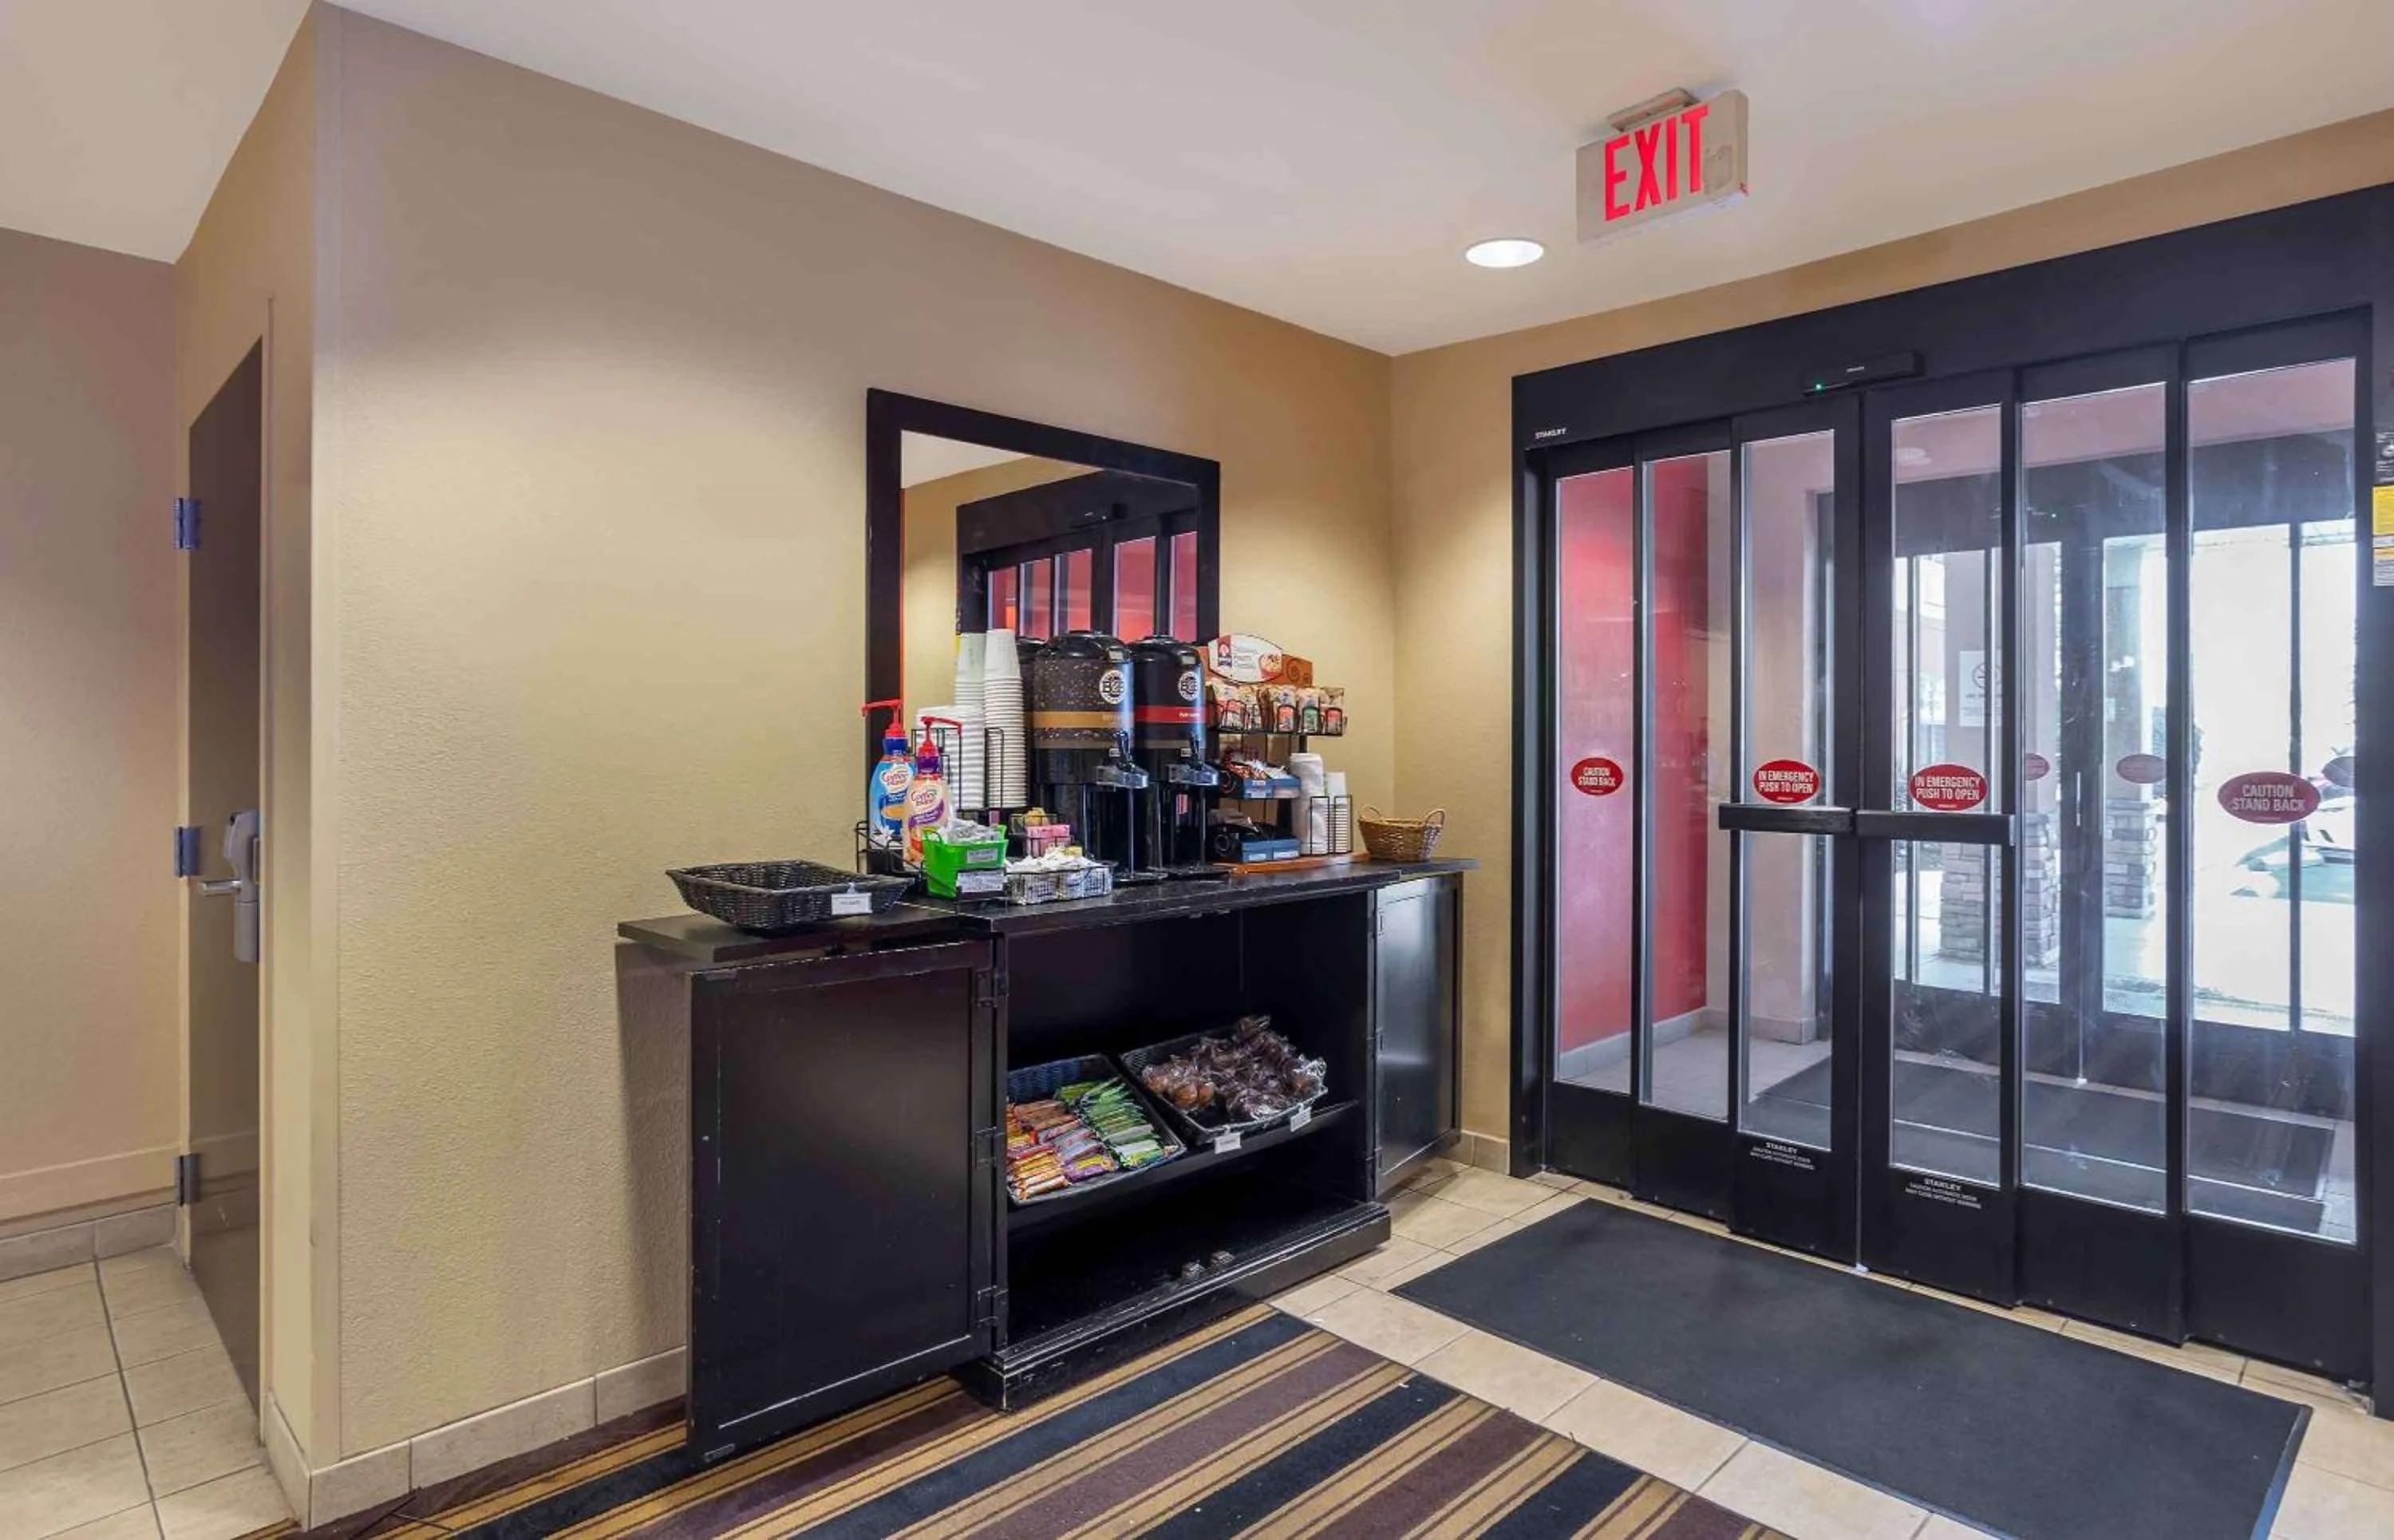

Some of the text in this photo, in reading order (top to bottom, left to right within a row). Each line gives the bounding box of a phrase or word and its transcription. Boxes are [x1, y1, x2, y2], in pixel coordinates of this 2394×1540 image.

[1605, 104, 1709, 222] EXIT
[1535, 427, 1566, 440] STANLEY
[1582, 767, 1610, 776] CAUTION
[1758, 770, 1814, 783] IN EMERGENCY
[1578, 776, 1616, 788] STAND BACK
[1758, 781, 1814, 794] PUSH TO OPEN
[1914, 775, 1981, 790] IN EMERGENCY
[1916, 788, 1980, 800] PUSH TO OPEN
[2242, 784, 2295, 798] CAUTION
[2231, 797, 2305, 812] STAND BACK
